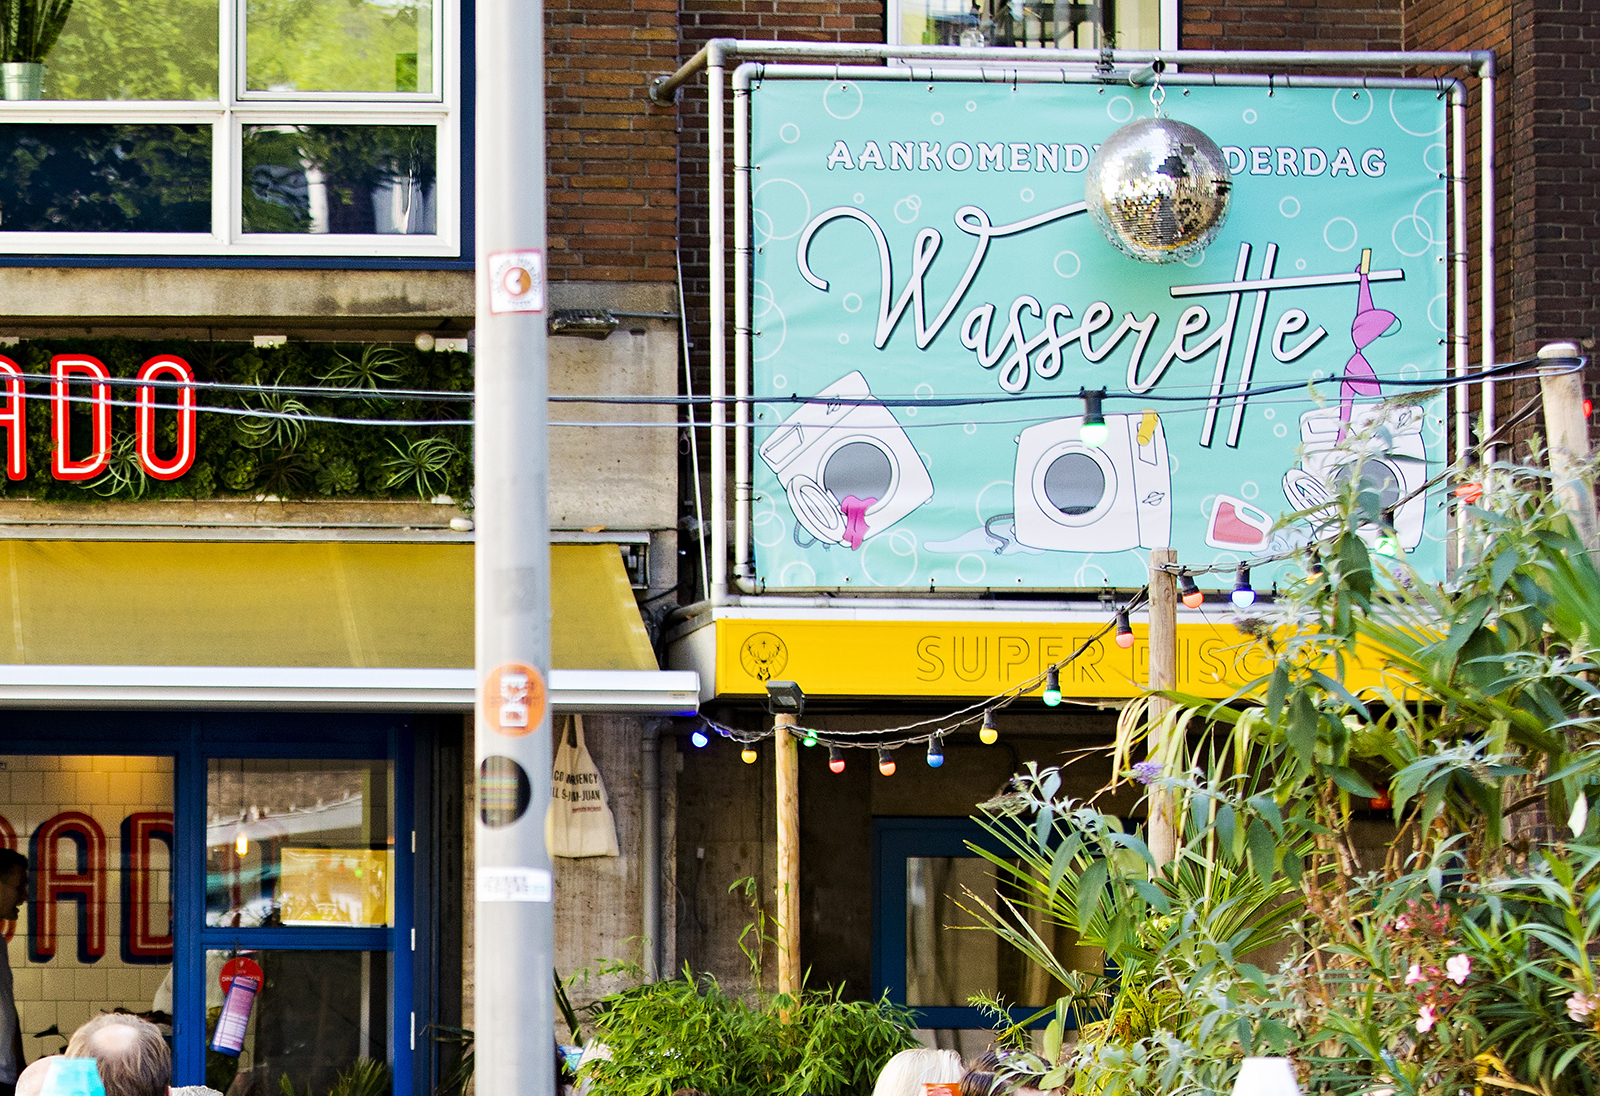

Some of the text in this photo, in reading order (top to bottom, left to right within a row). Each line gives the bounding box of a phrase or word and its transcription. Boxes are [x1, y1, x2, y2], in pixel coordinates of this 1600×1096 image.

[826, 140, 1388, 178] AANKOMEND DERDAG
[797, 201, 1404, 448] Wasserette
[915, 635, 1106, 683] SUPER
